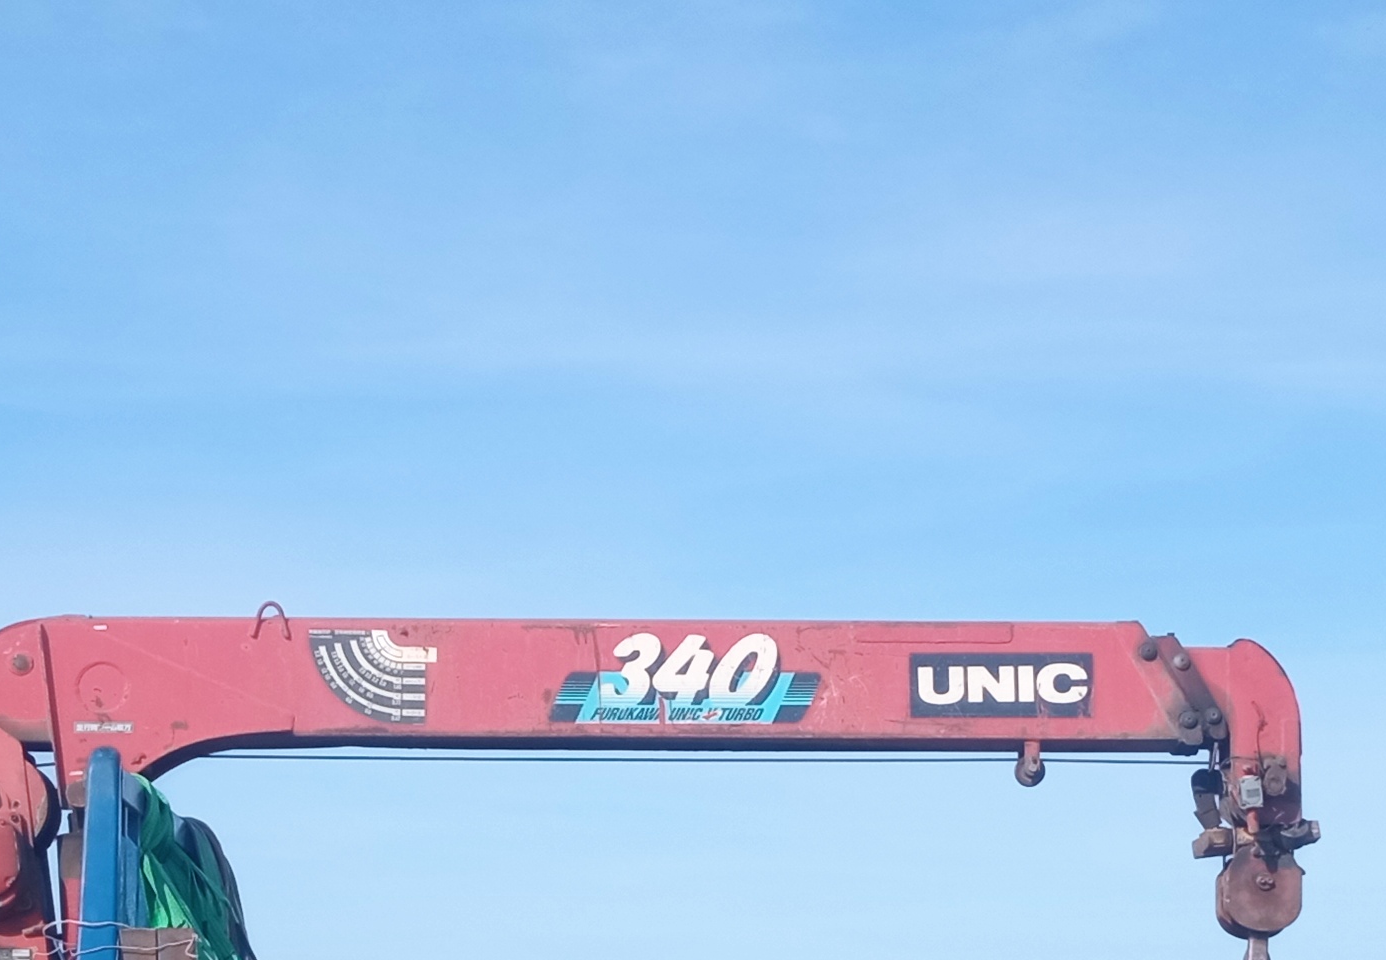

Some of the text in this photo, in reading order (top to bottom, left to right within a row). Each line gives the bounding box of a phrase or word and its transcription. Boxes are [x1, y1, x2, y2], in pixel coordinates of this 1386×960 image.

[600, 633, 778, 705] 340
[917, 663, 1088, 705] UNIC
[668, 707, 703, 721] UNIC
[718, 707, 765, 721] TURBO
